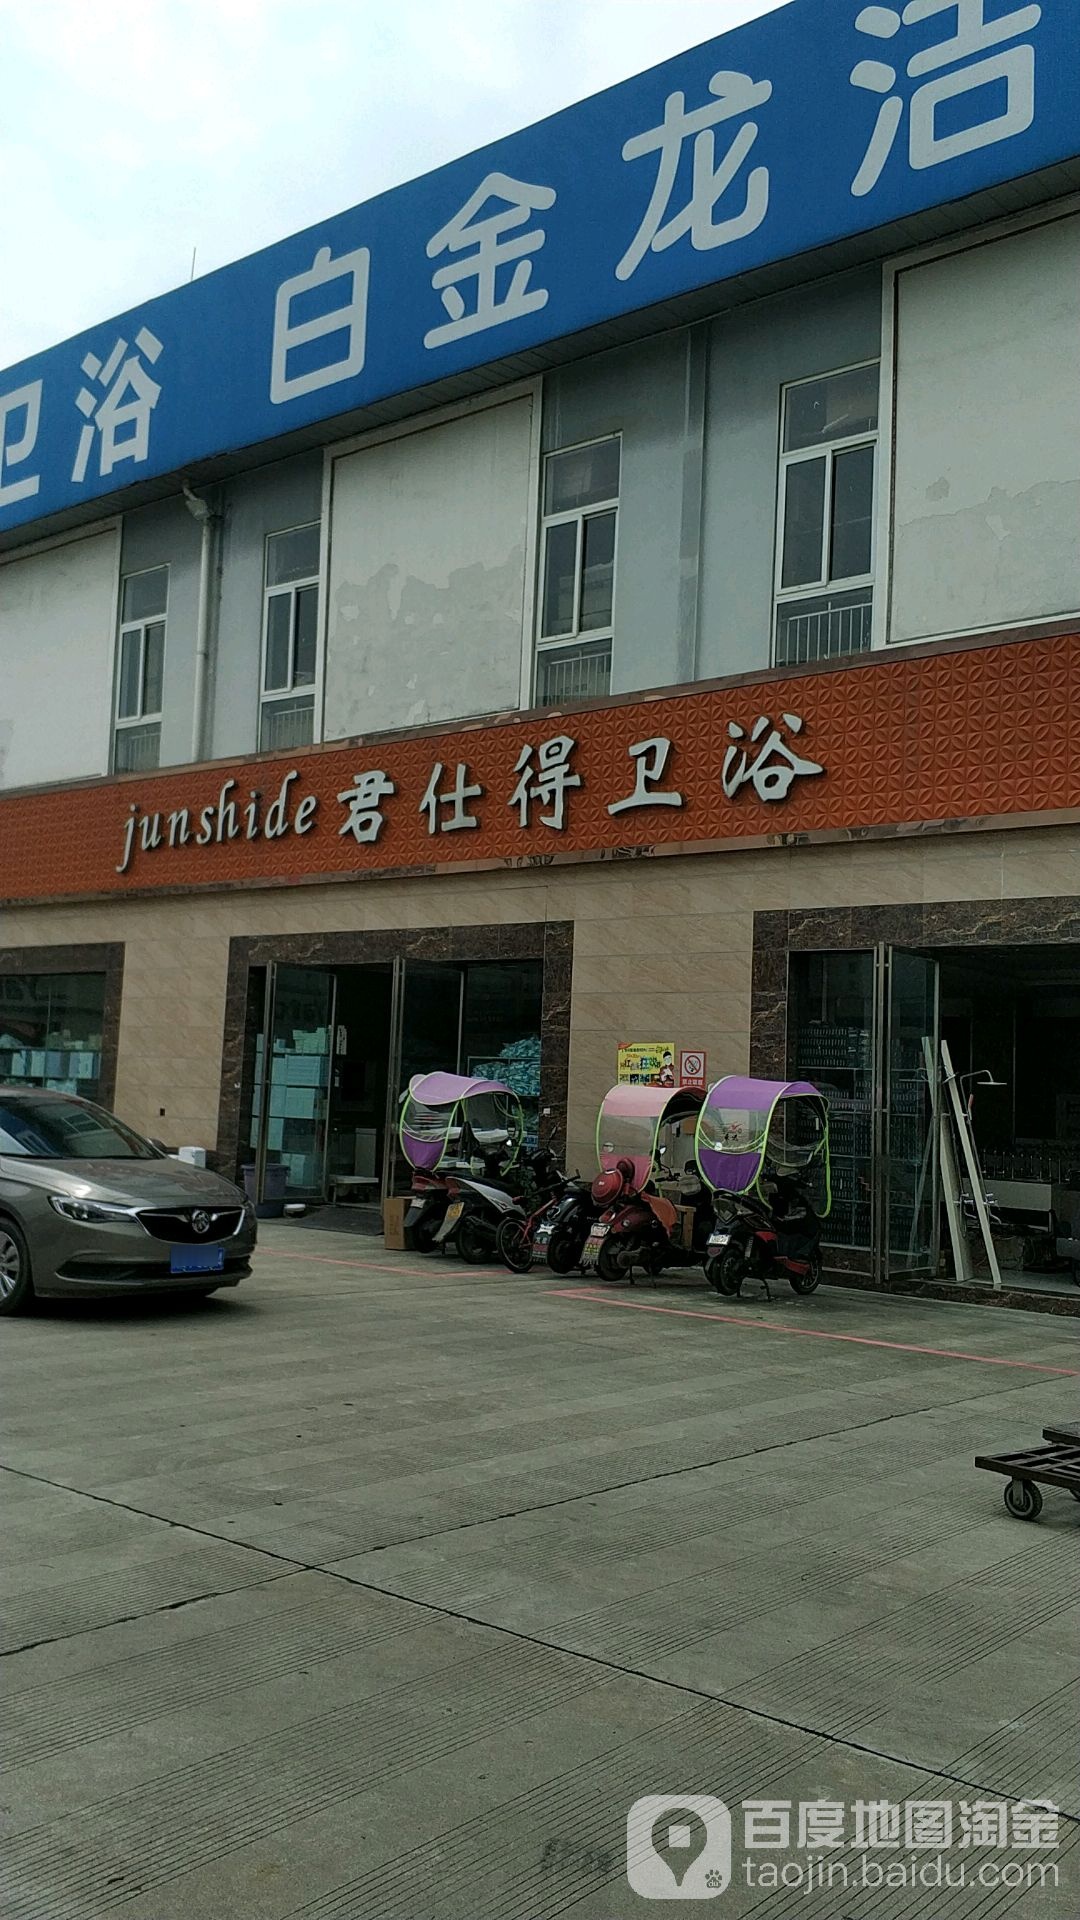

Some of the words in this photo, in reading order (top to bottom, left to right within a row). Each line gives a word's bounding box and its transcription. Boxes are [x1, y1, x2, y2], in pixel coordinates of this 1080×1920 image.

[0, 327, 162, 508] 卫浴
[116, 770, 318, 873] junshide
[336, 712, 825, 845] 君仕得卫浴
